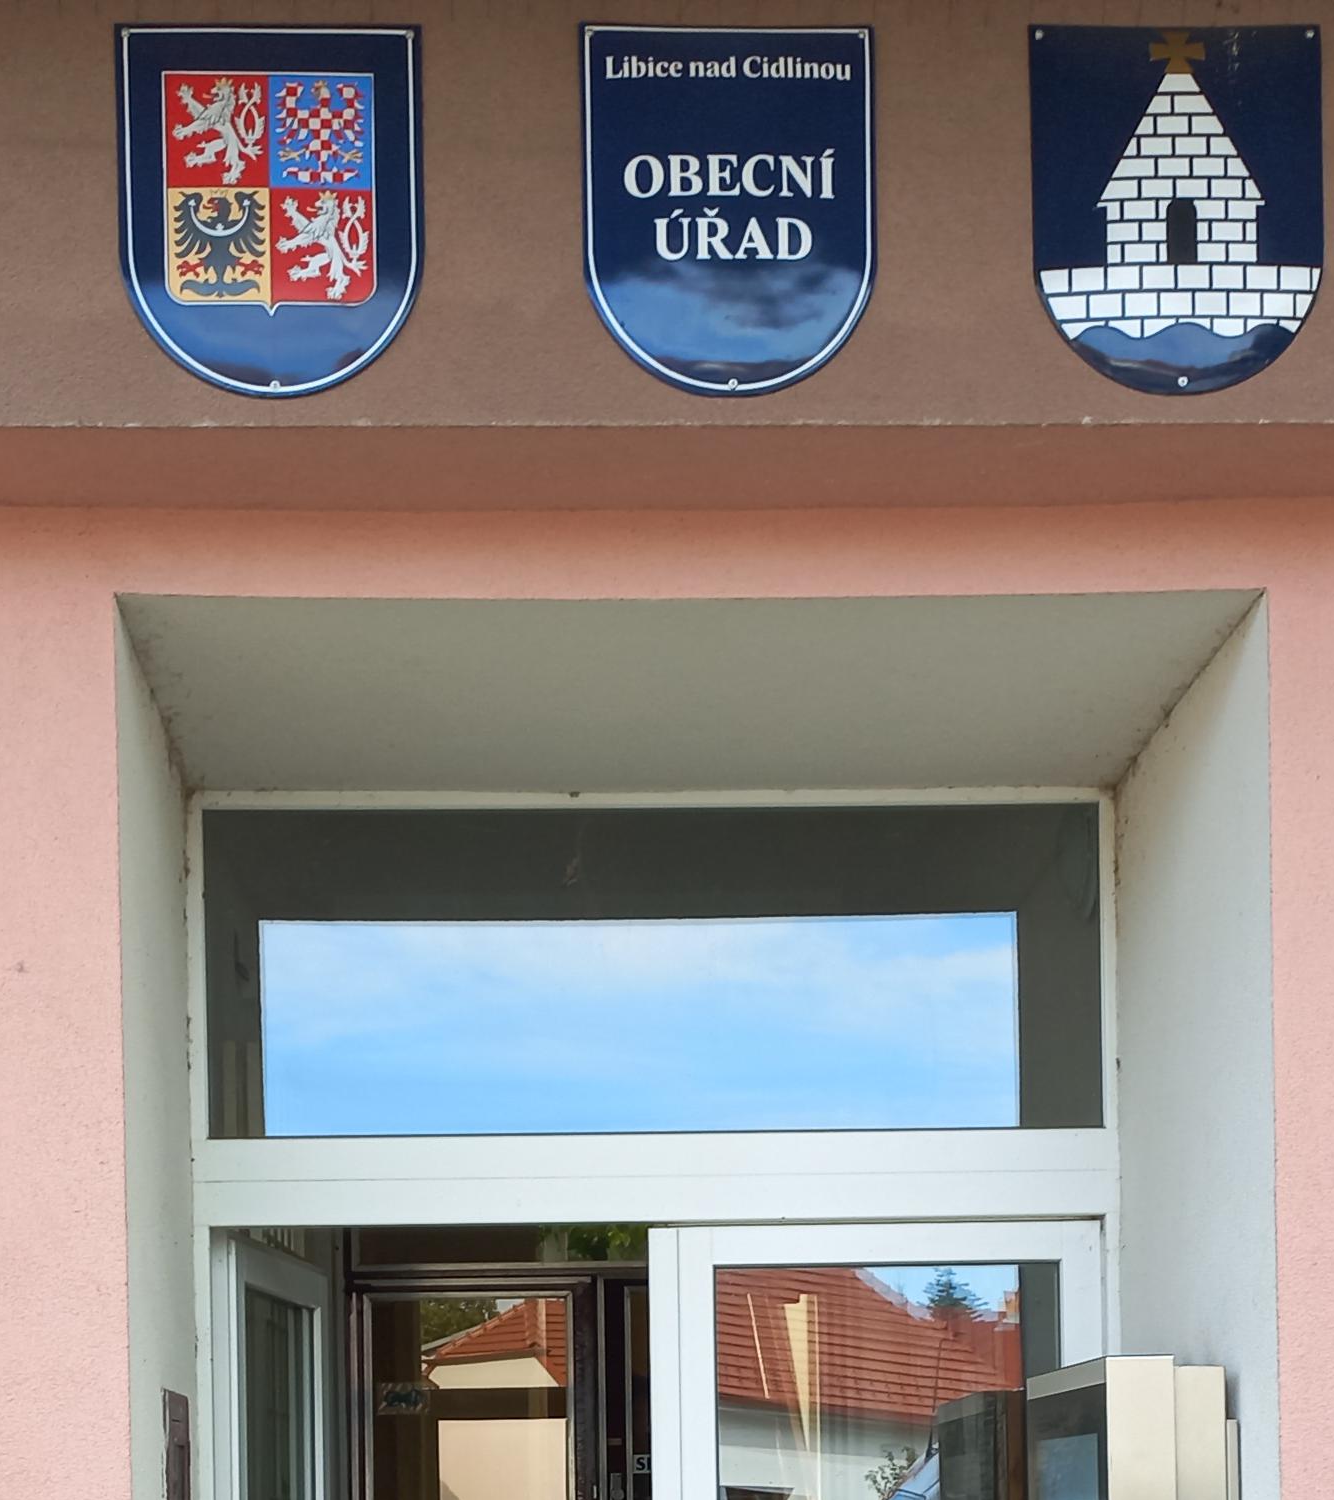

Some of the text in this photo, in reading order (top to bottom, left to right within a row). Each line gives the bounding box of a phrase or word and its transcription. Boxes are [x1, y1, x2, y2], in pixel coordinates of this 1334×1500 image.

[605, 55, 851, 81] Libice nad Cidlinou
[623, 148, 835, 199] OBECNÍ
[654, 207, 812, 261] ÚŘAD
